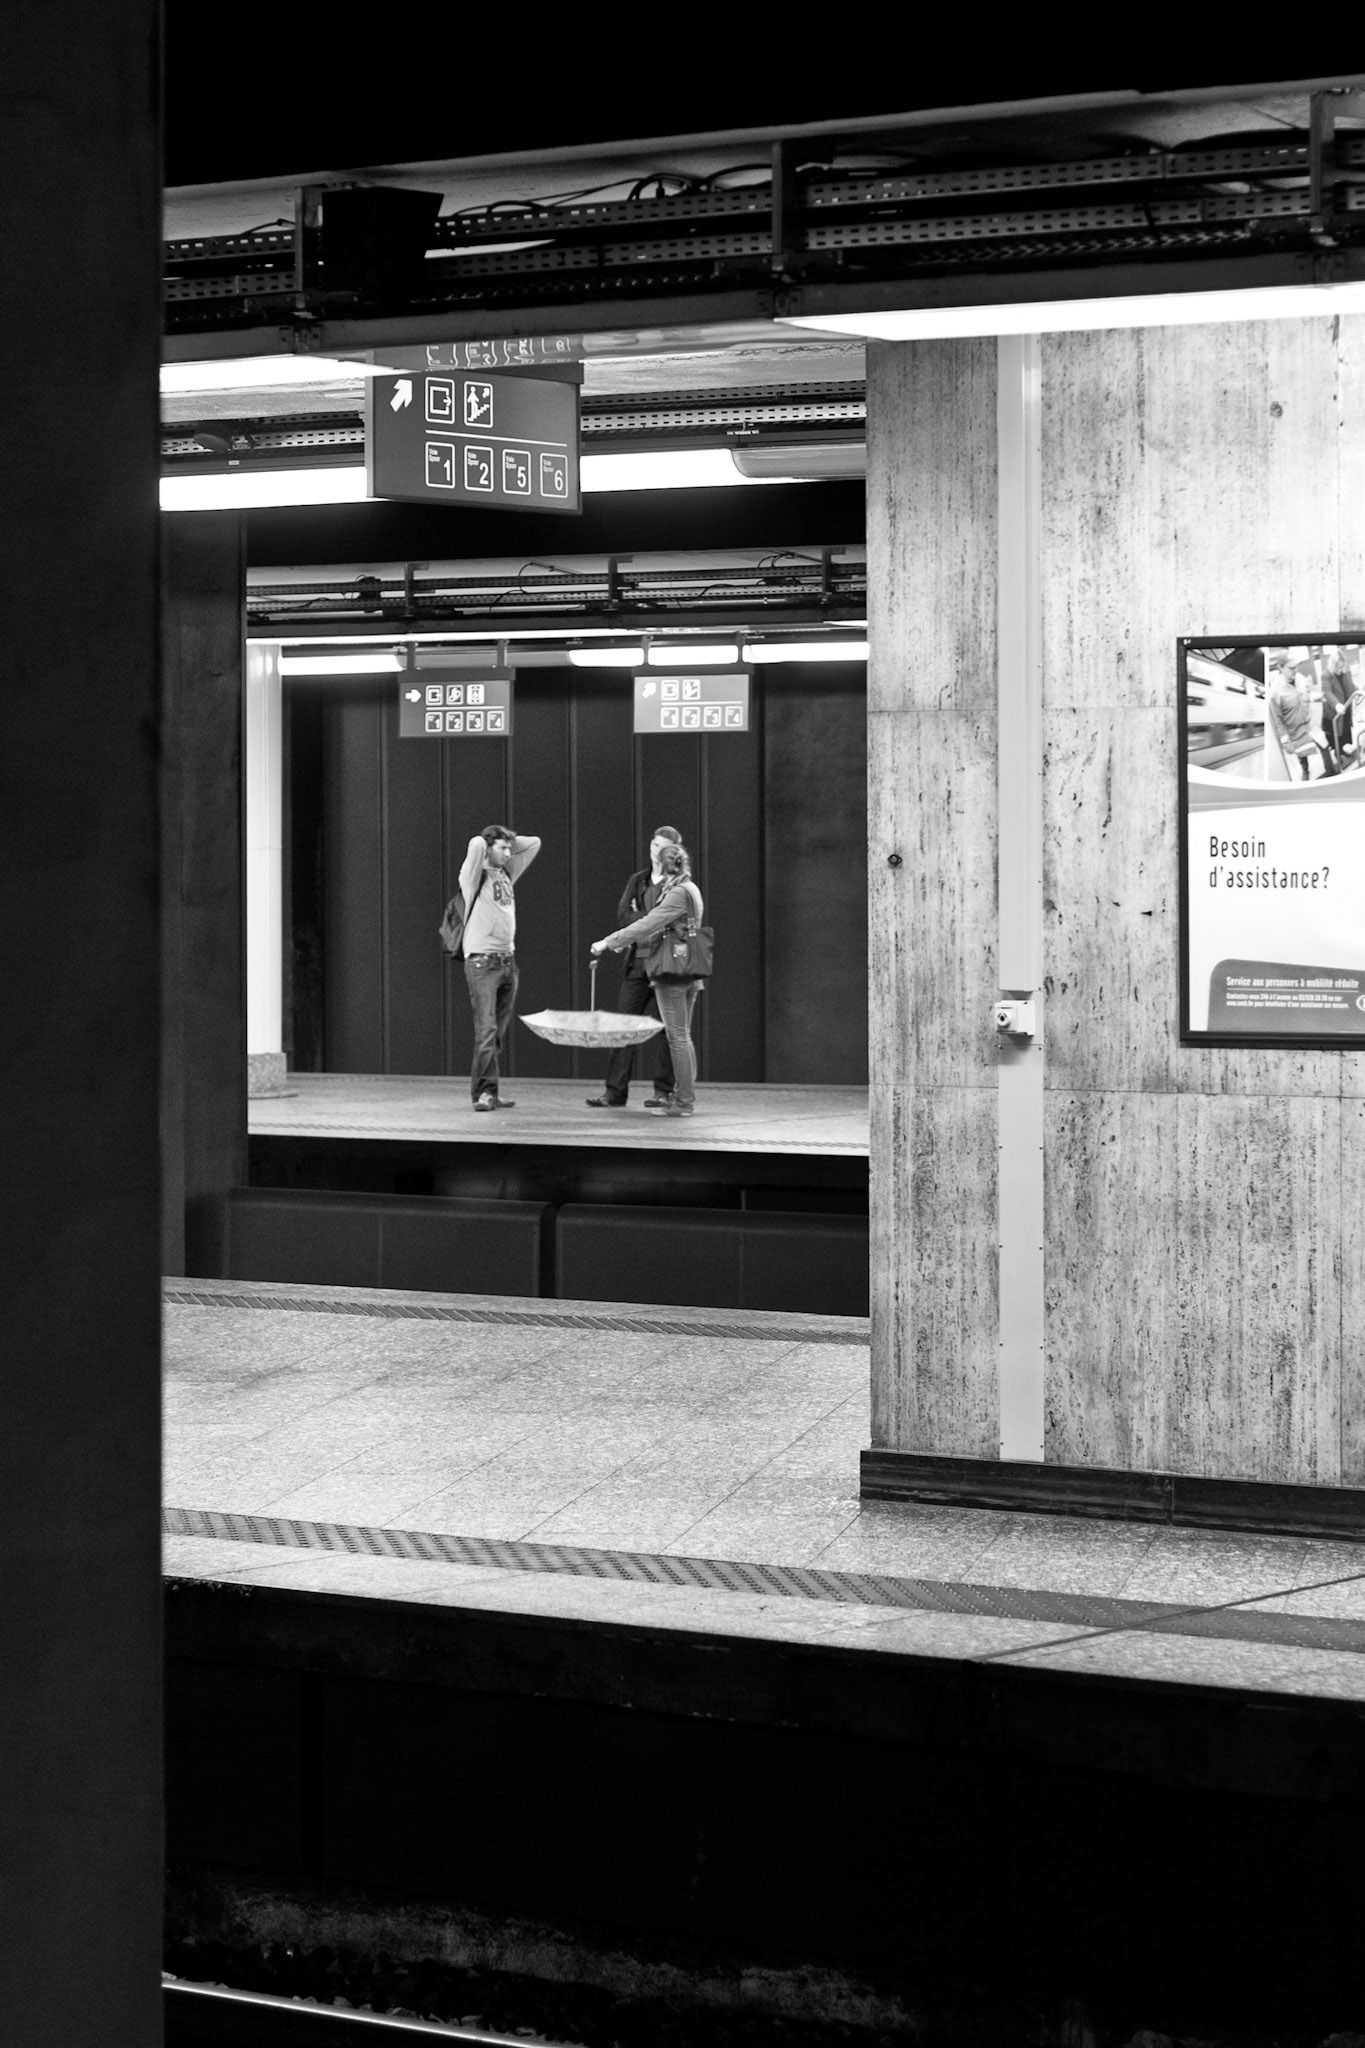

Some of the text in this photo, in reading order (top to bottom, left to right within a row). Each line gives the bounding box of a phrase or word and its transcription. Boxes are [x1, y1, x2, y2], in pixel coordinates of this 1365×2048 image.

[444, 460, 451, 482] 1
[479, 463, 489, 485] 2
[517, 466, 527, 488] 5
[554, 470, 564, 491] 6
[435, 719, 440, 729] 1
[454, 718, 460, 729] 2
[474, 718, 481, 729] 3
[495, 718, 502, 728] 4
[671, 714, 677, 725] 1
[690, 713, 697, 725] 2
[712, 713, 718, 724] 3
[733, 713, 740, 723] 4
[1210, 836, 1266, 858] Besoin
[1209, 866, 1330, 889] d'assistance?
[1226, 976, 1251, 986] Service
[1265, 979, 1299, 988] personnes
[1306, 978, 1333, 988] mobilité
[1334, 979, 1359, 988] réduite
